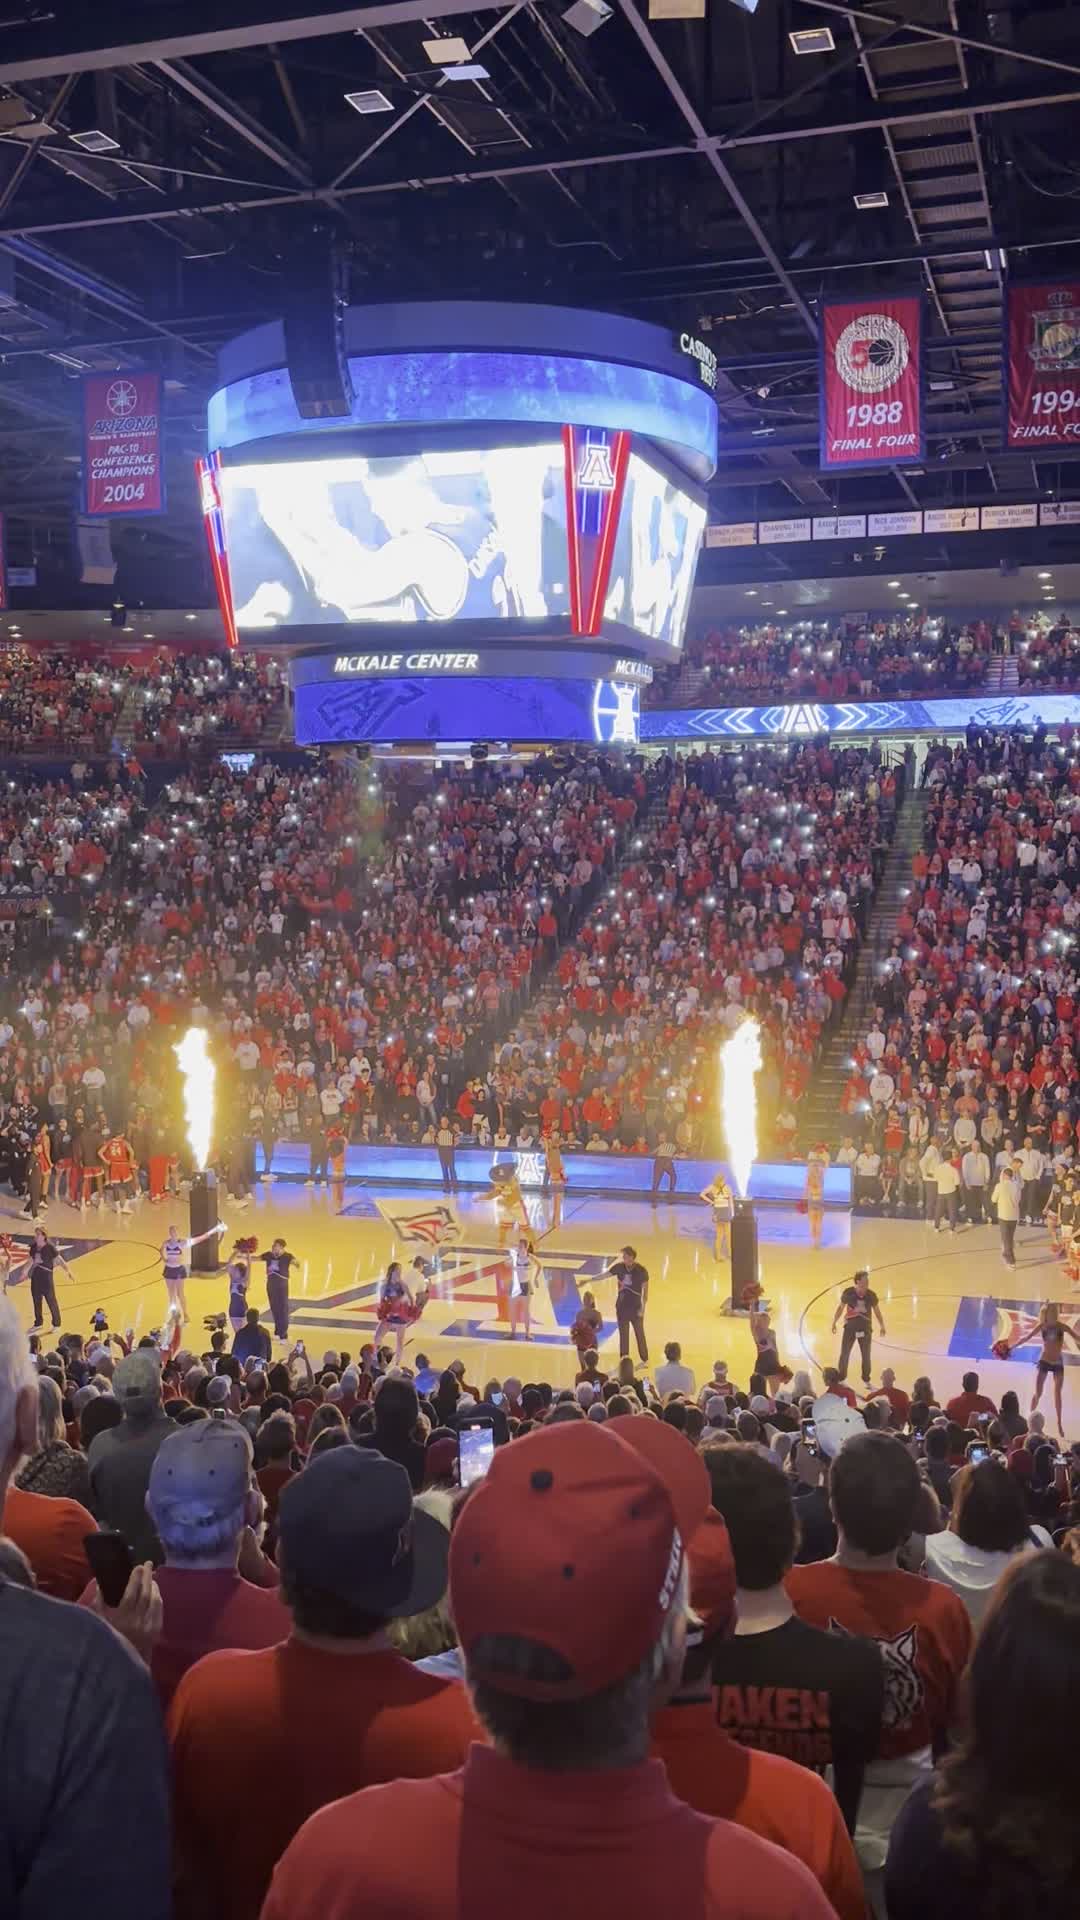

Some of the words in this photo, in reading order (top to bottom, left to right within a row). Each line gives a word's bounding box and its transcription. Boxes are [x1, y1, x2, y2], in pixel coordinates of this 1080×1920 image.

[94, 415, 158, 434] ARIZONA
[846, 401, 903, 429] 1988
[1013, 425, 1058, 438] FINAL
[107, 443, 139, 455] PAC-10
[832, 438, 873, 452] FINAL
[877, 433, 916, 448] FOUR
[91, 453, 156, 467] CONFERENCE
[91, 465, 155, 479] CHAMPIONS
[103, 483, 145, 502] 2004
[334, 654, 404, 672] MCKALE
[405, 652, 480, 670] CENTER
[615, 659, 648, 677] MCKALE
[711, 1685, 832, 1729] AKEN
